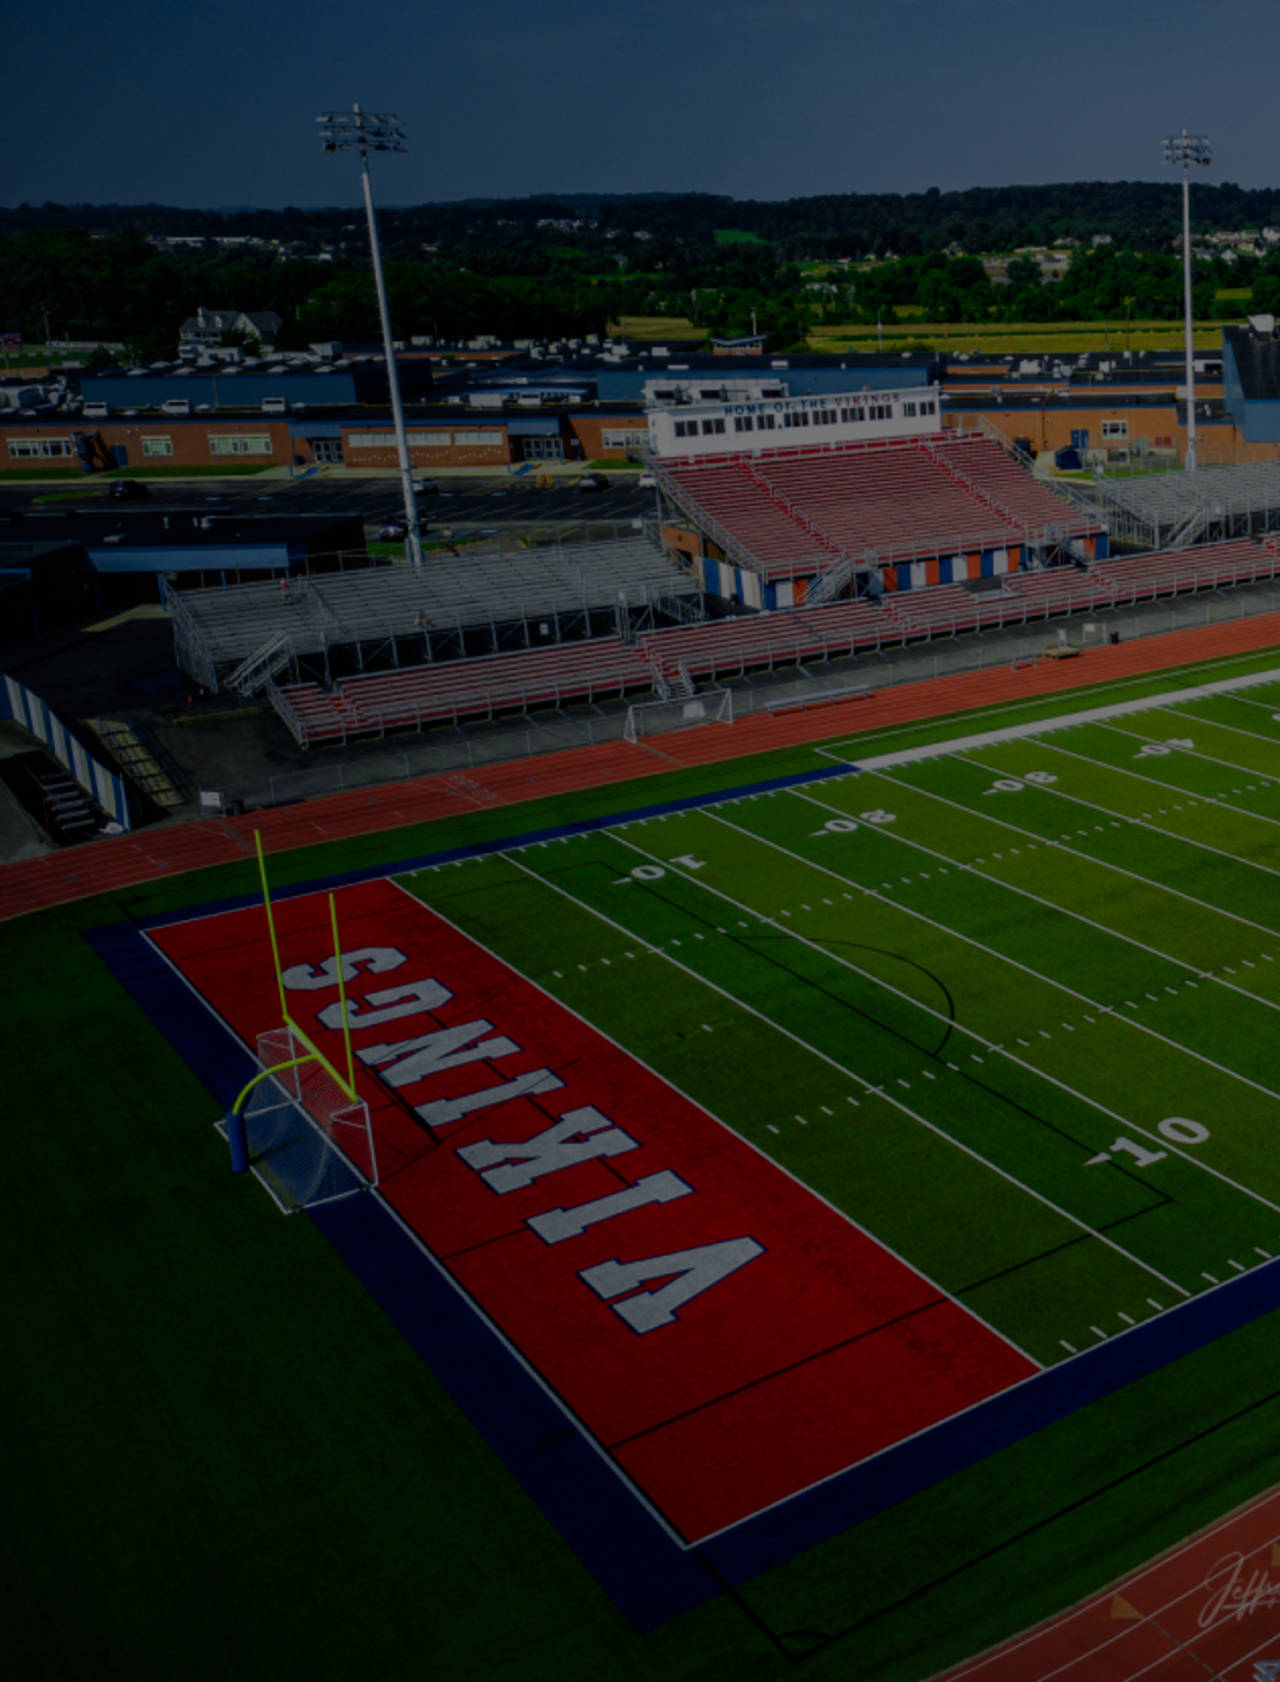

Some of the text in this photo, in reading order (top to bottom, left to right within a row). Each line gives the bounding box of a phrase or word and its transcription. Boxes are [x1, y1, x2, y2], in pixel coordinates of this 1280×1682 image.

[724, 393, 901, 417] HOME OF THE VIKINGS
[992, 770, 1060, 792] 30
[823, 808, 897, 833] 20
[630, 853, 708, 881] 10
[276, 945, 768, 1336] VIKINGS
[1108, 1116, 1210, 1168] 10
